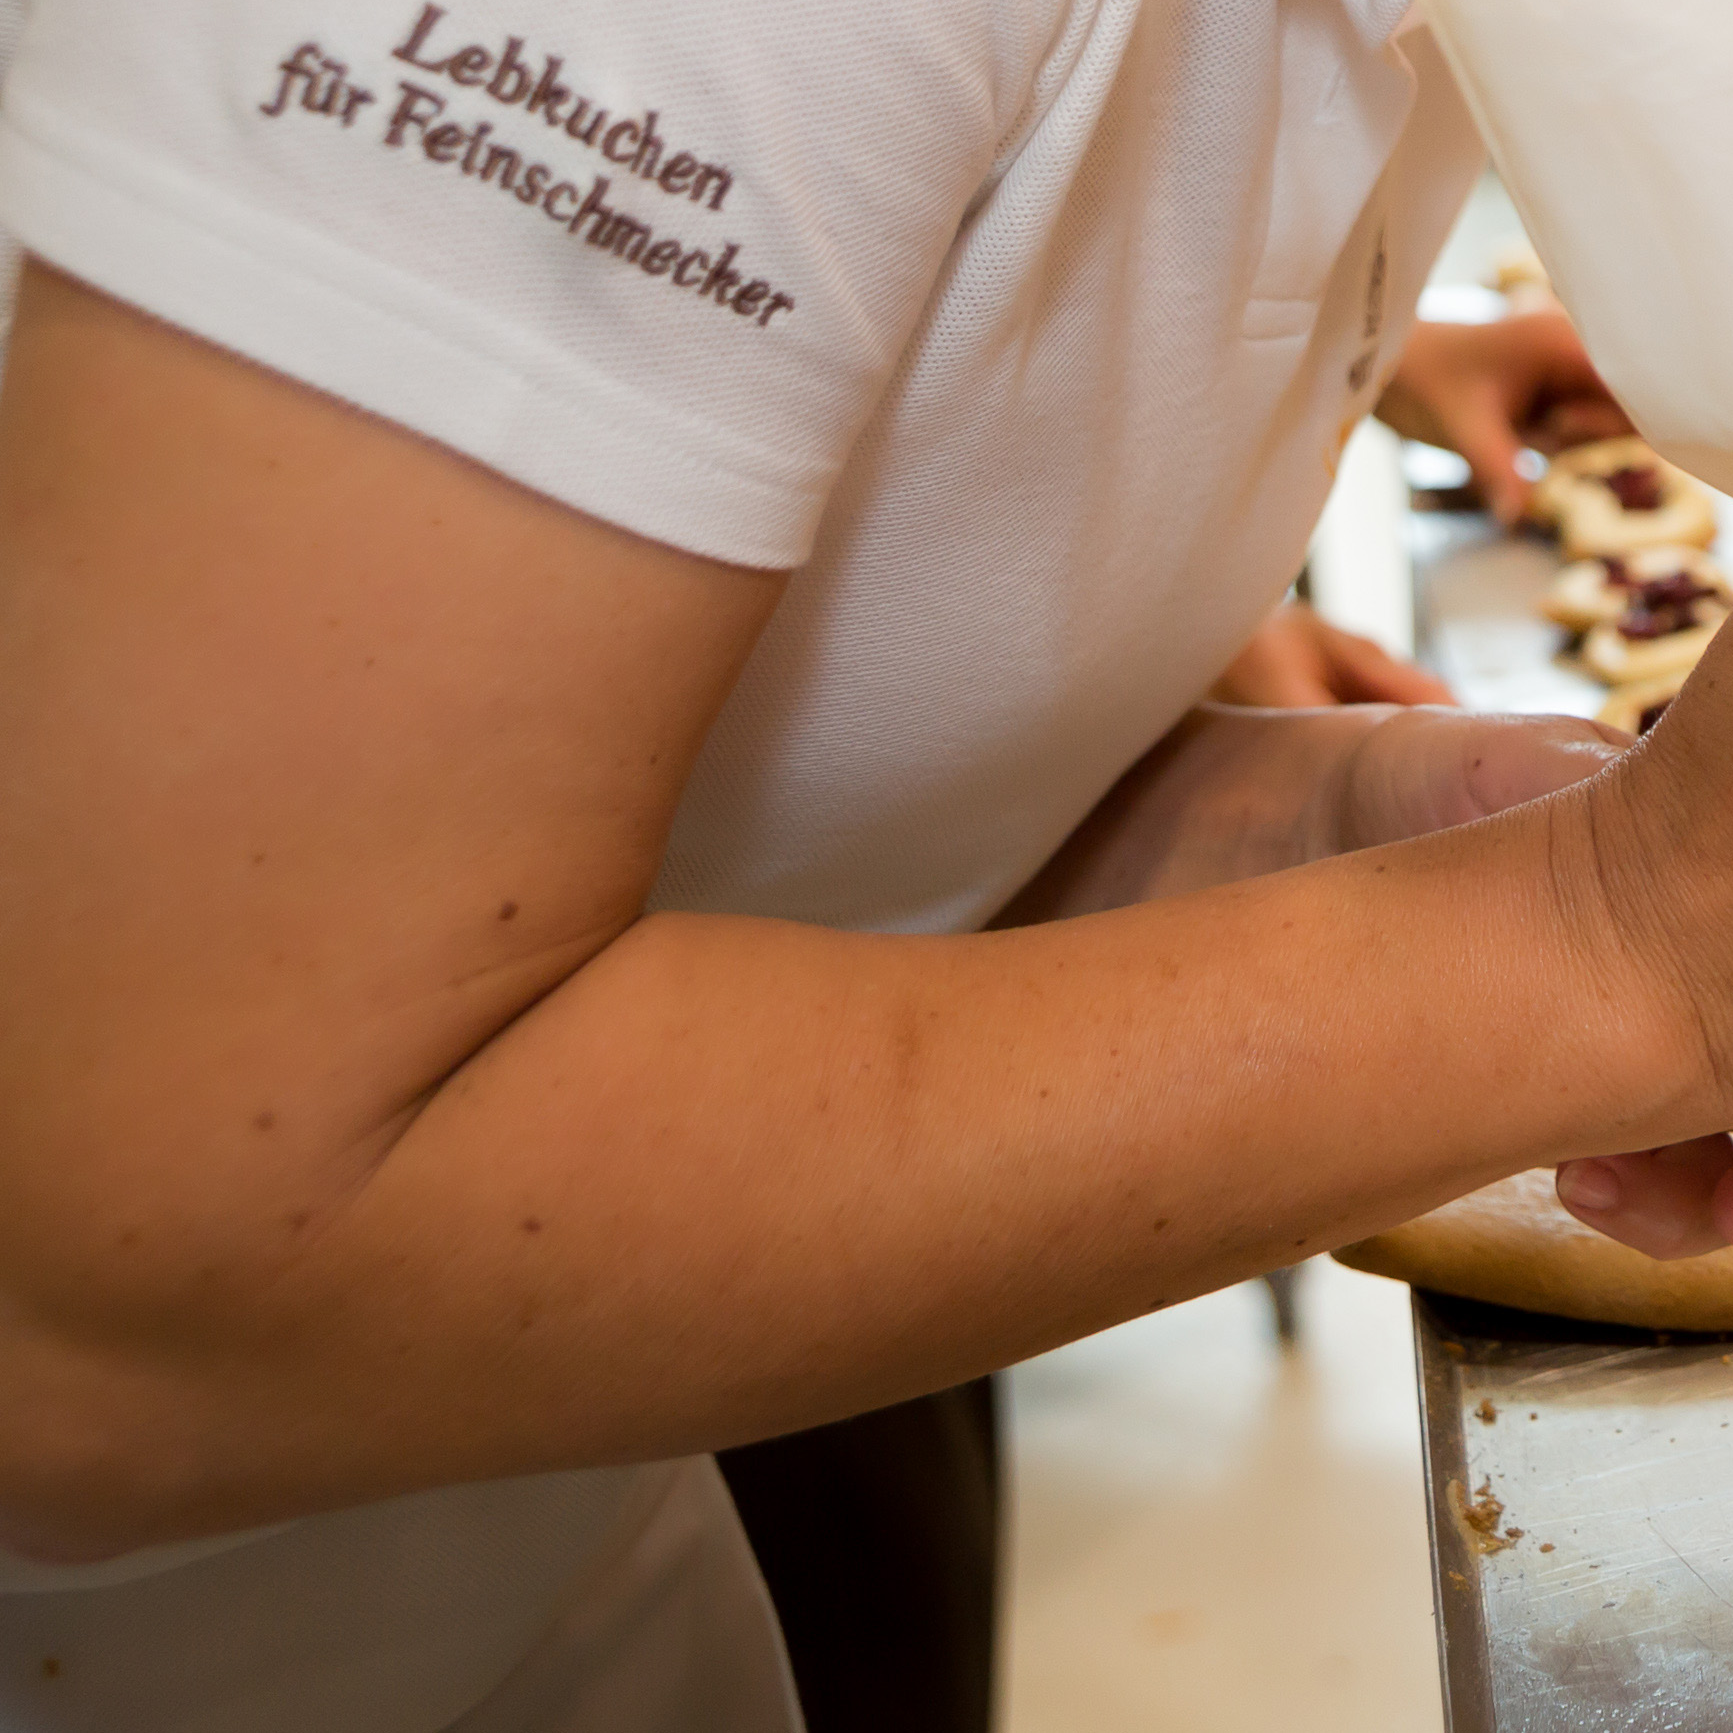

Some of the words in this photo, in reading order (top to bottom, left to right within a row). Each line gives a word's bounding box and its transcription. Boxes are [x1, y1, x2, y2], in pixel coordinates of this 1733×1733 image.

[258, 42, 376, 127] für
[382, 80, 796, 328] Feinschmecker
[390, 1, 733, 211] Lebkuchen
